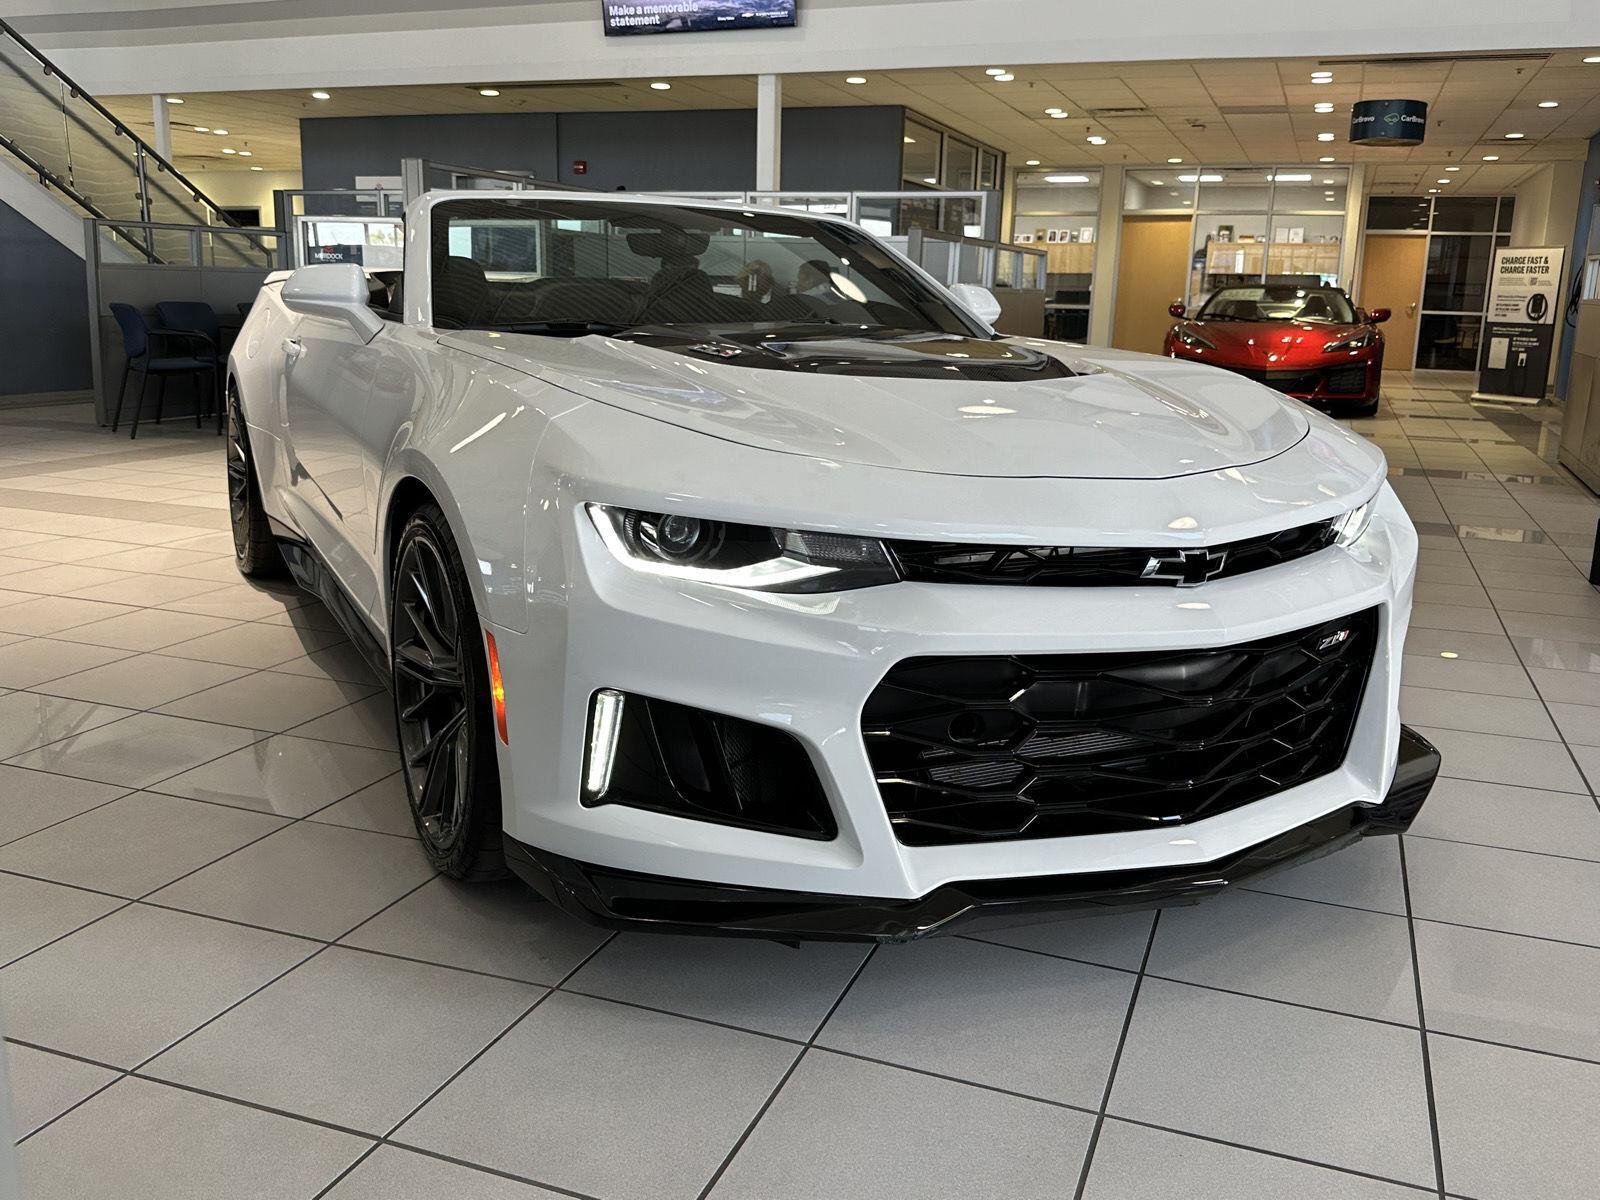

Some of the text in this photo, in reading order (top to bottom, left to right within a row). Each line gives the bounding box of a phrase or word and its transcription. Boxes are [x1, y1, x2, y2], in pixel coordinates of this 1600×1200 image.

[609, 1, 699, 16] Make a memorable
[610, 14, 660, 27] statement
[1501, 256, 1549, 265] CHARGE FAST &
[1500, 265, 1550, 274] CHARGE FASTER
